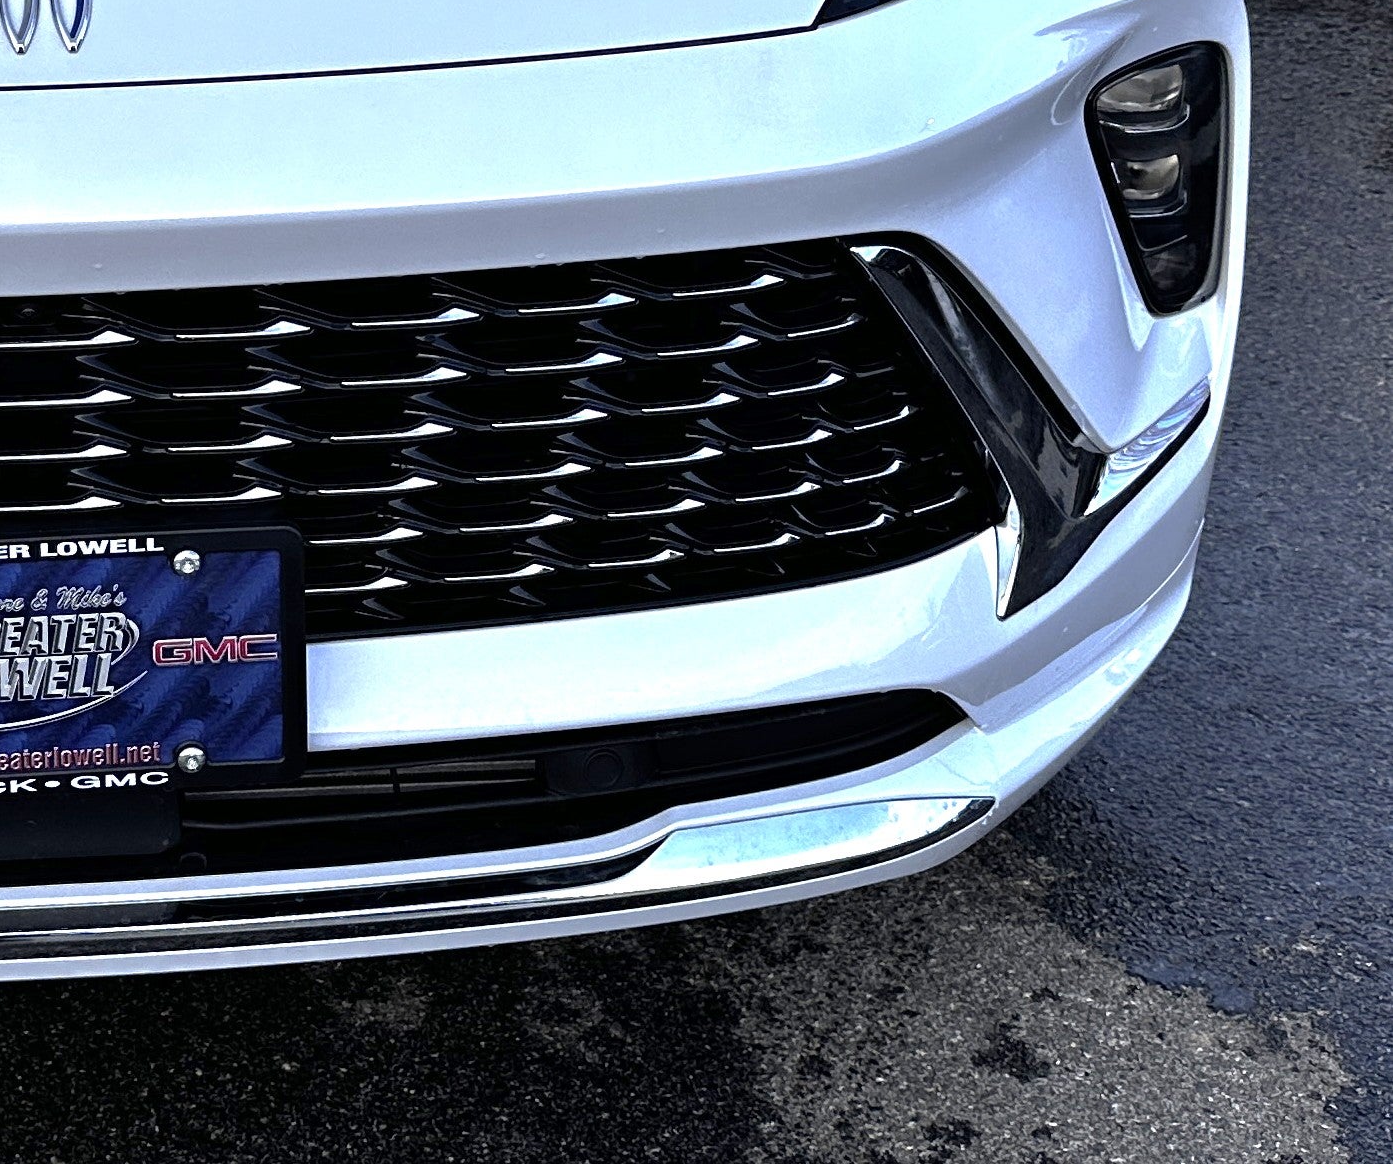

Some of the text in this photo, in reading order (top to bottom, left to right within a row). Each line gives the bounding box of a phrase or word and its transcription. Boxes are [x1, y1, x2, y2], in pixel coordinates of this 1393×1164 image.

[39, 537, 165, 557] LOWELL
[30, 588, 49, 611] &
[55, 583, 127, 611] Mike's
[152, 633, 278, 666] GMC
[70, 771, 169, 789] GMC
